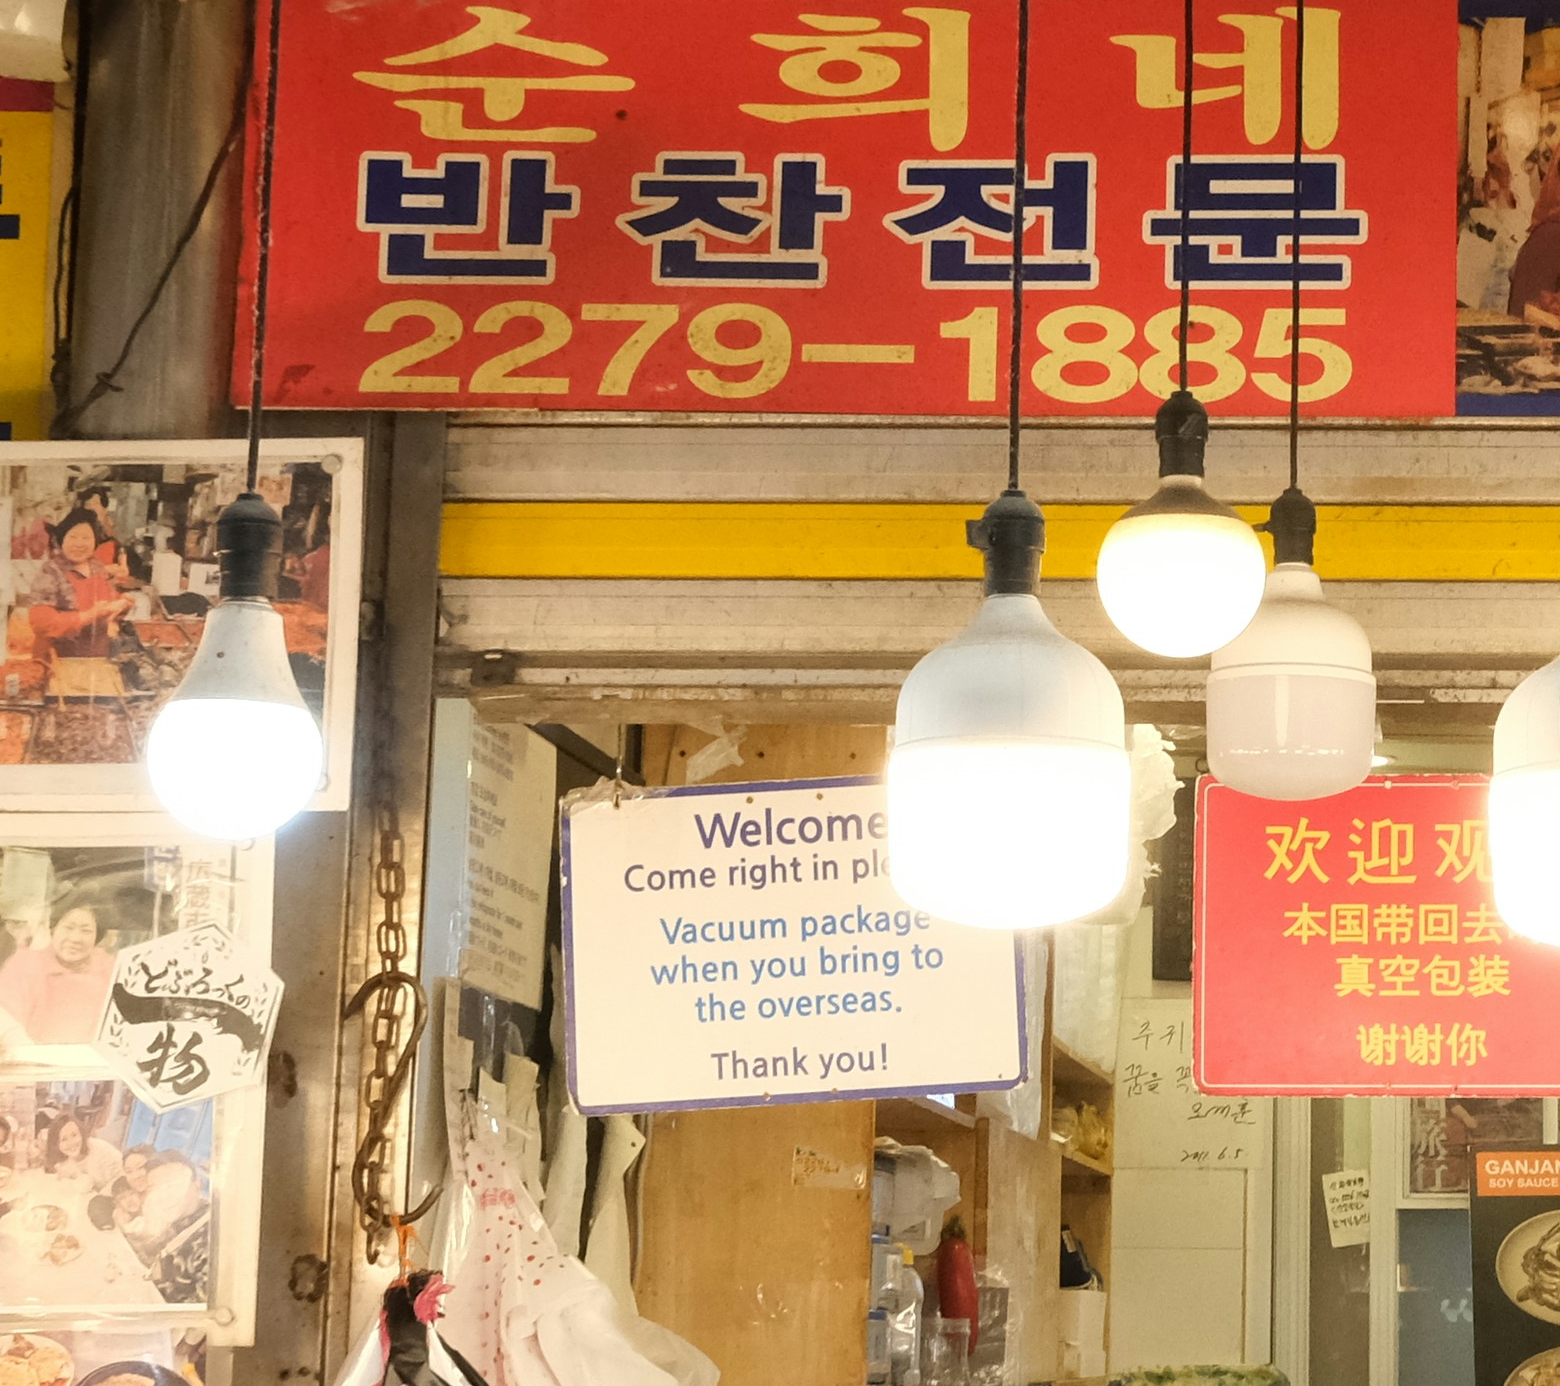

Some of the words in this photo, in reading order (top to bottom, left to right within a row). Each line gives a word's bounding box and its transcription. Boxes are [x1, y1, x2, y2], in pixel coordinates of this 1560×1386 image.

[352, 5, 1342, 152] 순희네
[354, 149, 1369, 290] 반찬전문
[358, 297, 1354, 404] 2279-1885
[694, 807, 887, 849] Welcome
[1263, 817, 1494, 886] 欢迎观
[624, 863, 716, 893] Come
[729, 855, 802, 890] right
[812, 854, 839, 881] in
[659, 917, 788, 945] Vacuum
[801, 905, 930, 942] package
[1283, 902, 1517, 946] 本国带回去
[651, 955, 738, 986] when
[750, 957, 807, 985] you
[820, 946, 900, 976] bring
[912, 943, 944, 969] to
[1334, 954, 1511, 998] 真空包装
[696, 993, 746, 1022] the
[758, 989, 903, 1020] overseas.
[711, 1046, 809, 1080] Thank
[819, 1043, 889, 1074] you!
[1356, 1022, 1488, 1067] 谢谢你
[1488, 1178, 1514, 1189] SOY
[1517, 1177, 1558, 1188] SAUCE
